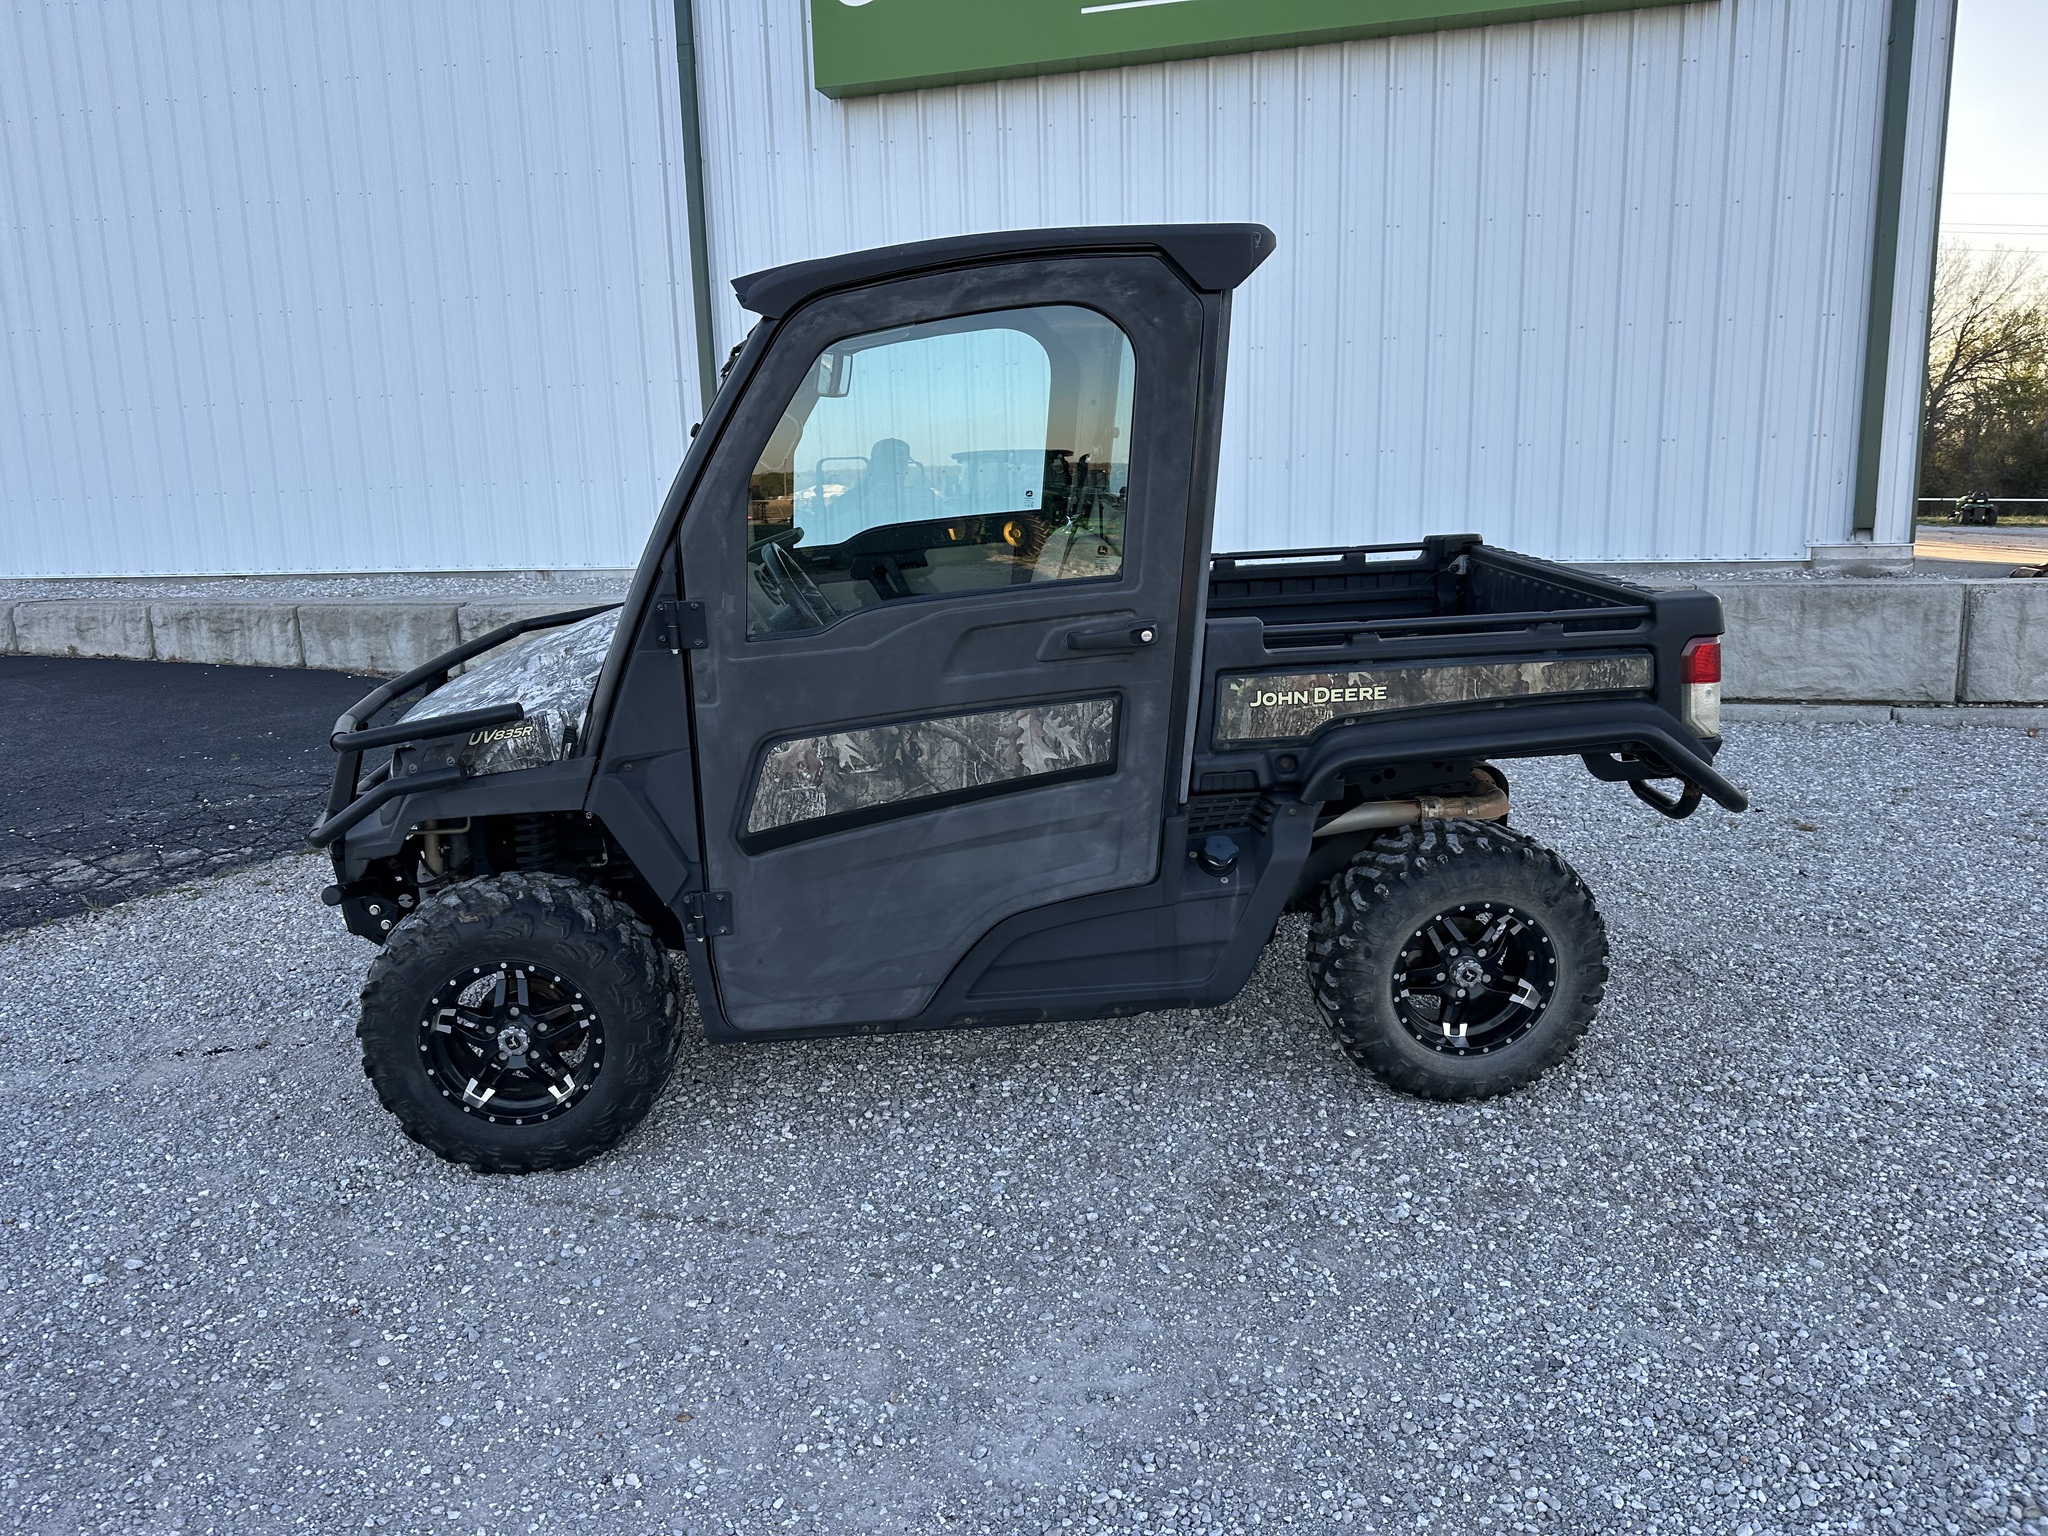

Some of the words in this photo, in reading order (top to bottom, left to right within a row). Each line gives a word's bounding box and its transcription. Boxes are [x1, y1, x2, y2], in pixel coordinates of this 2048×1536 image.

[1250, 690, 1309, 707] JOHN
[1314, 687, 1388, 703] DEERE
[468, 726, 533, 746] UV835R
